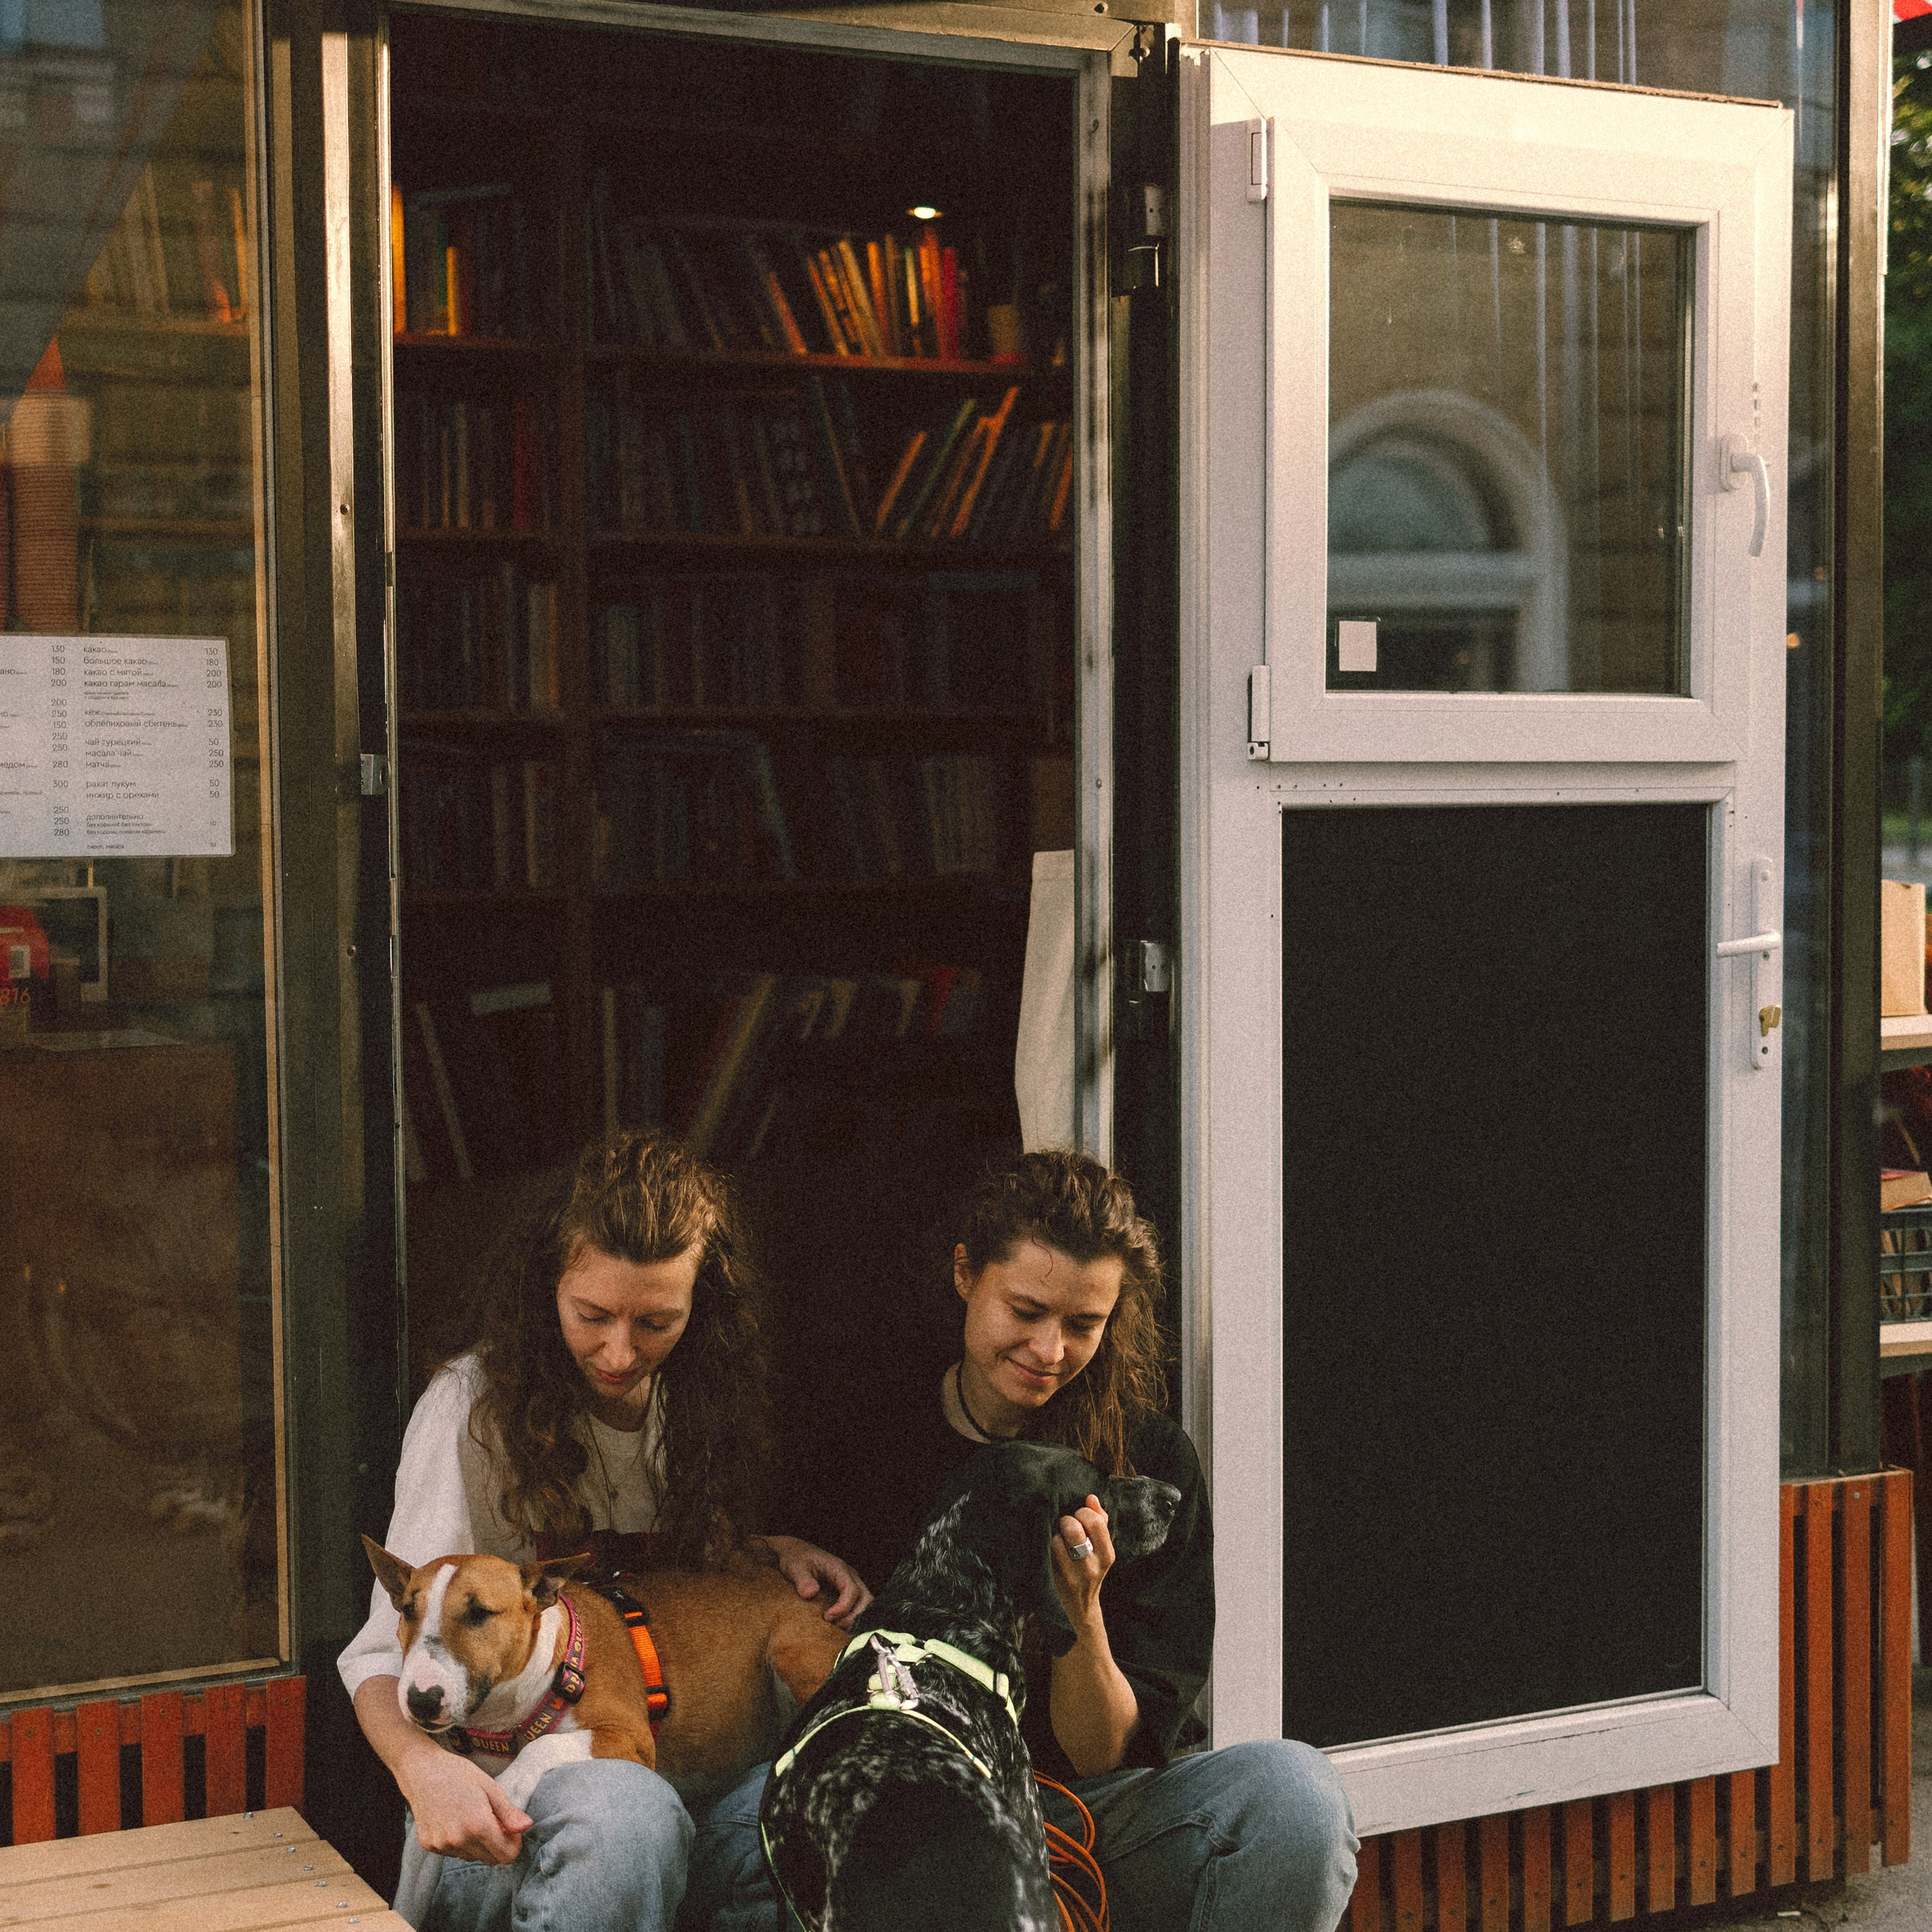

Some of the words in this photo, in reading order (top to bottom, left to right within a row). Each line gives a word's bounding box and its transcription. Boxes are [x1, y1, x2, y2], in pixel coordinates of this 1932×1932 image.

[85, 718, 141, 727] облепиховый
[85, 737, 99, 746] чай
[102, 738, 140, 747] турецкий
[524, 1712, 553, 1741] UEEN
